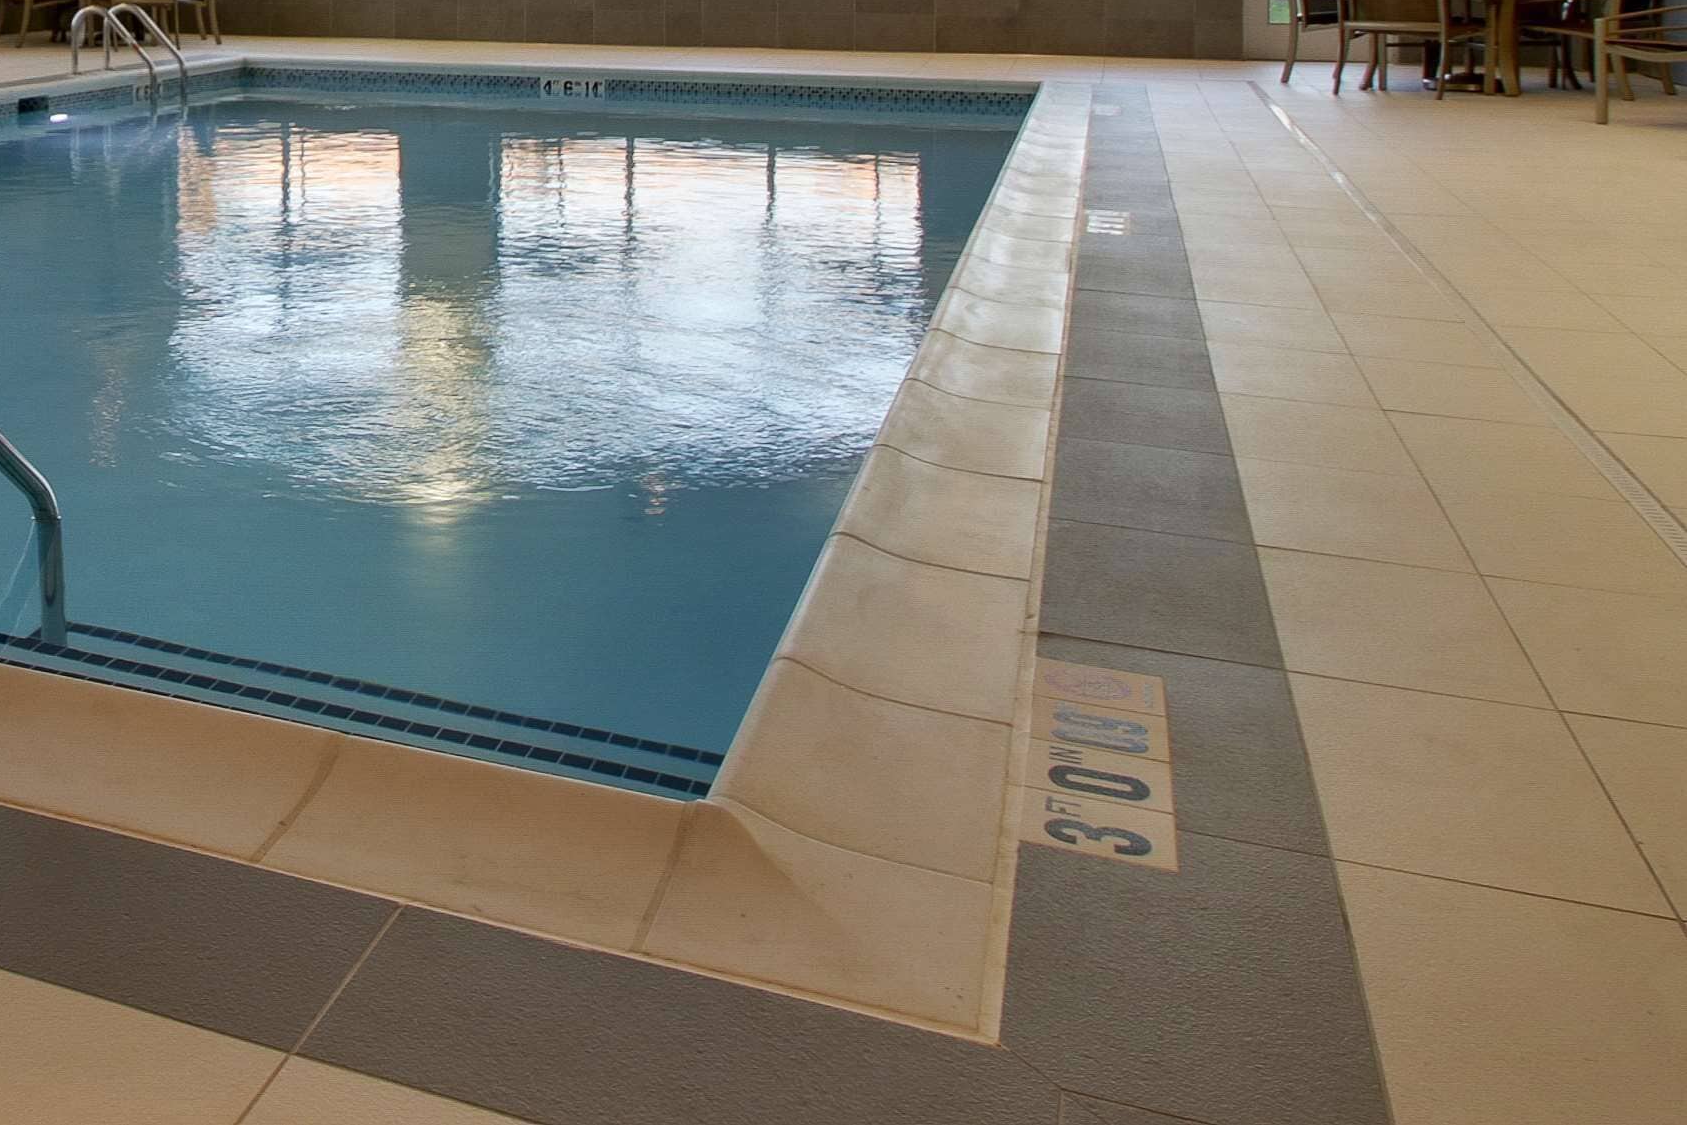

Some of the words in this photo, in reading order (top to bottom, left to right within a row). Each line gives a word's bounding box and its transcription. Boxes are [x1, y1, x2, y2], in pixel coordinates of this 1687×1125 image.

[1049, 746, 1083, 765] IN
[1048, 765, 1150, 801] 0
[1045, 796, 1082, 817] FT
[1044, 818, 1152, 856] 3
